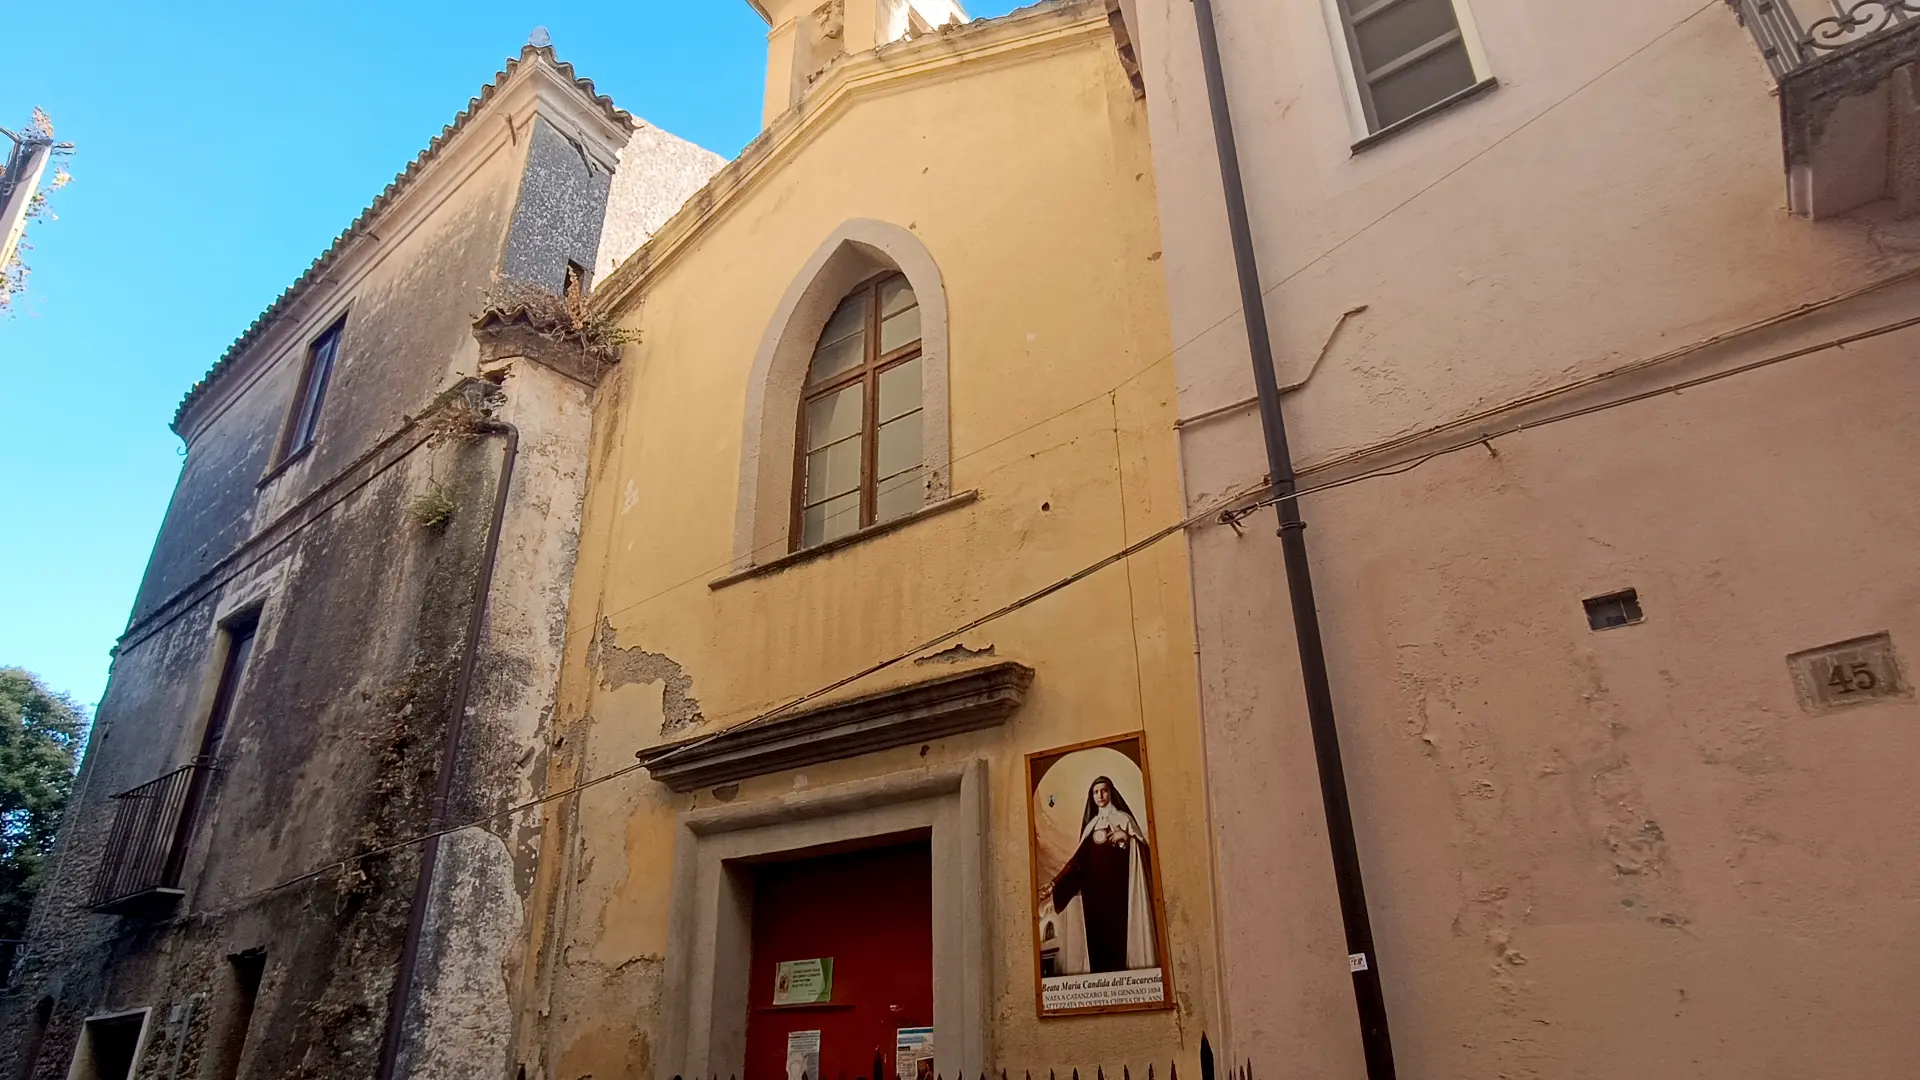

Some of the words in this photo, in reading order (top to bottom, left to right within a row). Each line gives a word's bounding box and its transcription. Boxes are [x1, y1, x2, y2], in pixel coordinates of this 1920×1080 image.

[1828, 662, 1876, 694] 45
[1042, 983, 1060, 993] Beata
[1061, 981, 1081, 991] Maria
[1082, 978, 1110, 989] Candida
[1111, 974, 1163, 987] dell'Eucarestia
[1066, 991, 1102, 1000] CATANZARO
[1117, 987, 1147, 996] GENNAIO
